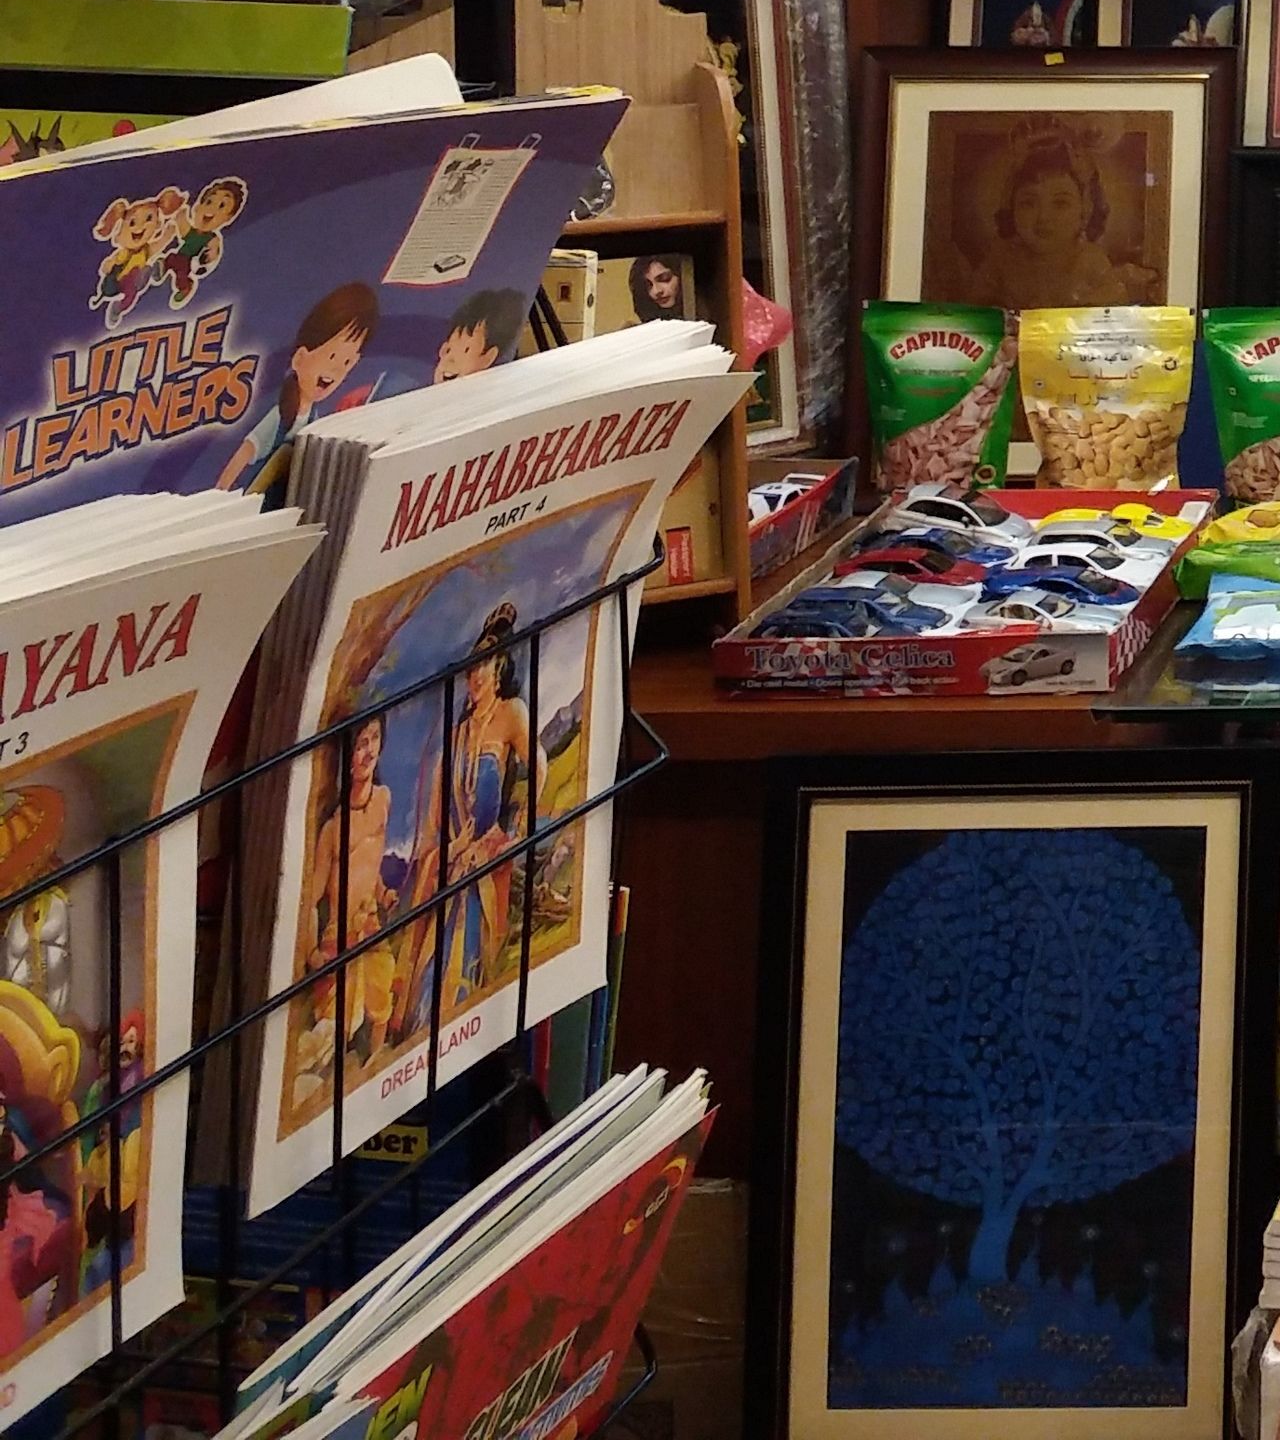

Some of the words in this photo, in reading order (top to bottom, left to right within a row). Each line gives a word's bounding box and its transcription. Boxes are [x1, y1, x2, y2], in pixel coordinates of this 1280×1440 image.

[53, 303, 233, 411] LITTLE
[889, 331, 985, 362] CAPILONA
[0, 354, 260, 494] LEARNERS
[380, 398, 692, 554] MAHABHARATA
[484, 501, 531, 536] PART
[535, 495, 549, 514] 4
[0, 592, 202, 725] YANA
[745, 644, 851, 678] Toyota
[858, 643, 956, 670] Celica
[14, 731, 30, 755] 3
[380, 1015, 482, 1101] DREALAND
